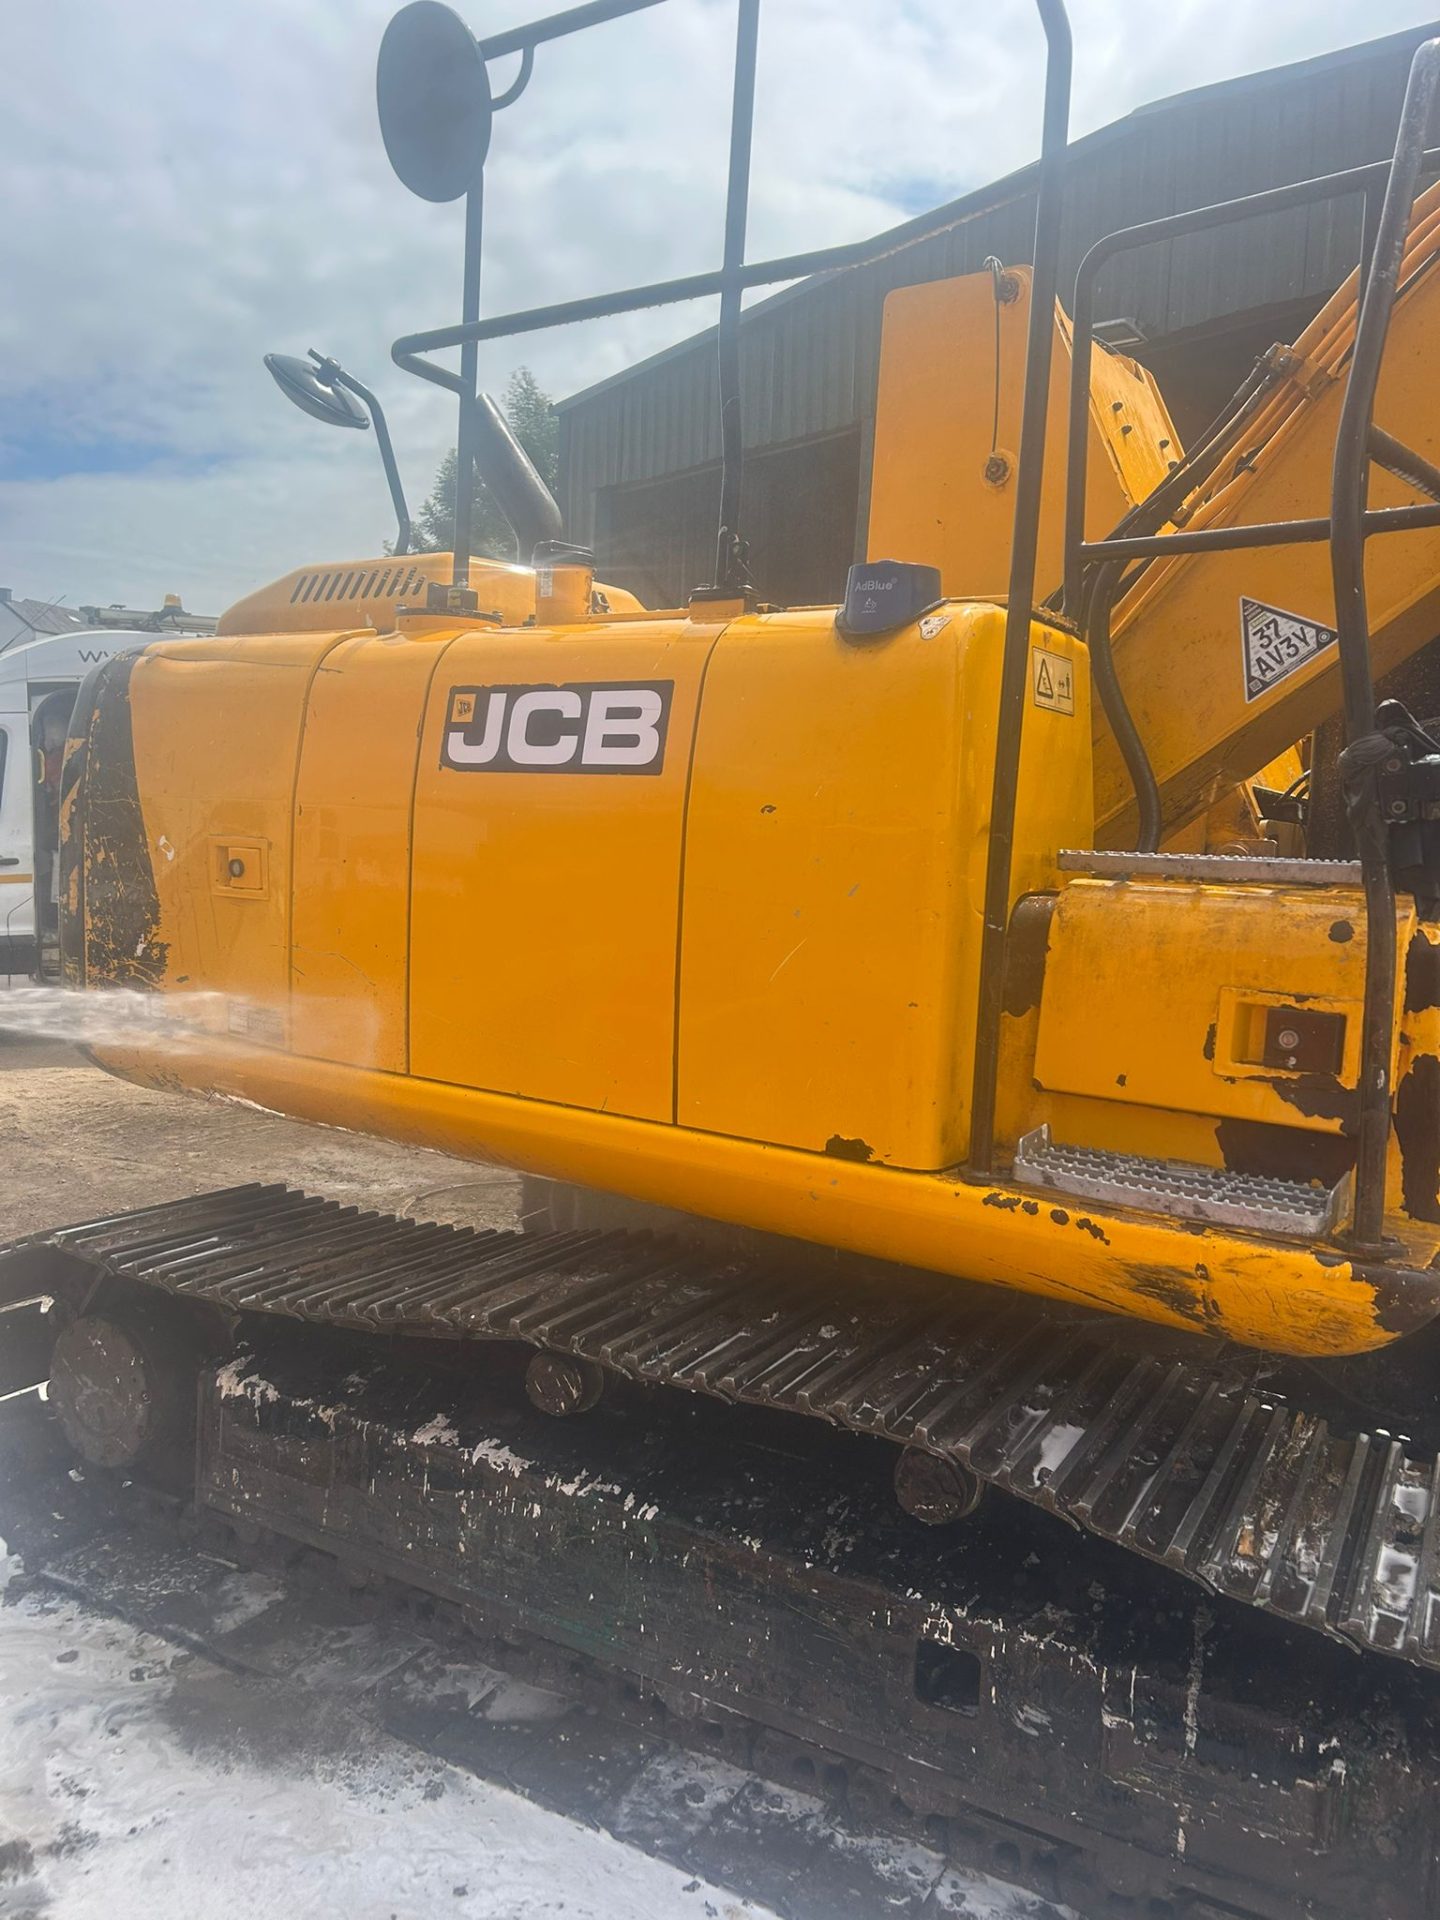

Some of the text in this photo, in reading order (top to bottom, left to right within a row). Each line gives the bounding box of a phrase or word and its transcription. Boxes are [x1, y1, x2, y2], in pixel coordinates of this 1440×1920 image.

[1253, 618, 1281, 649] 37
[1256, 626, 1310, 678] AV3Y
[447, 690, 662, 765] JCB
